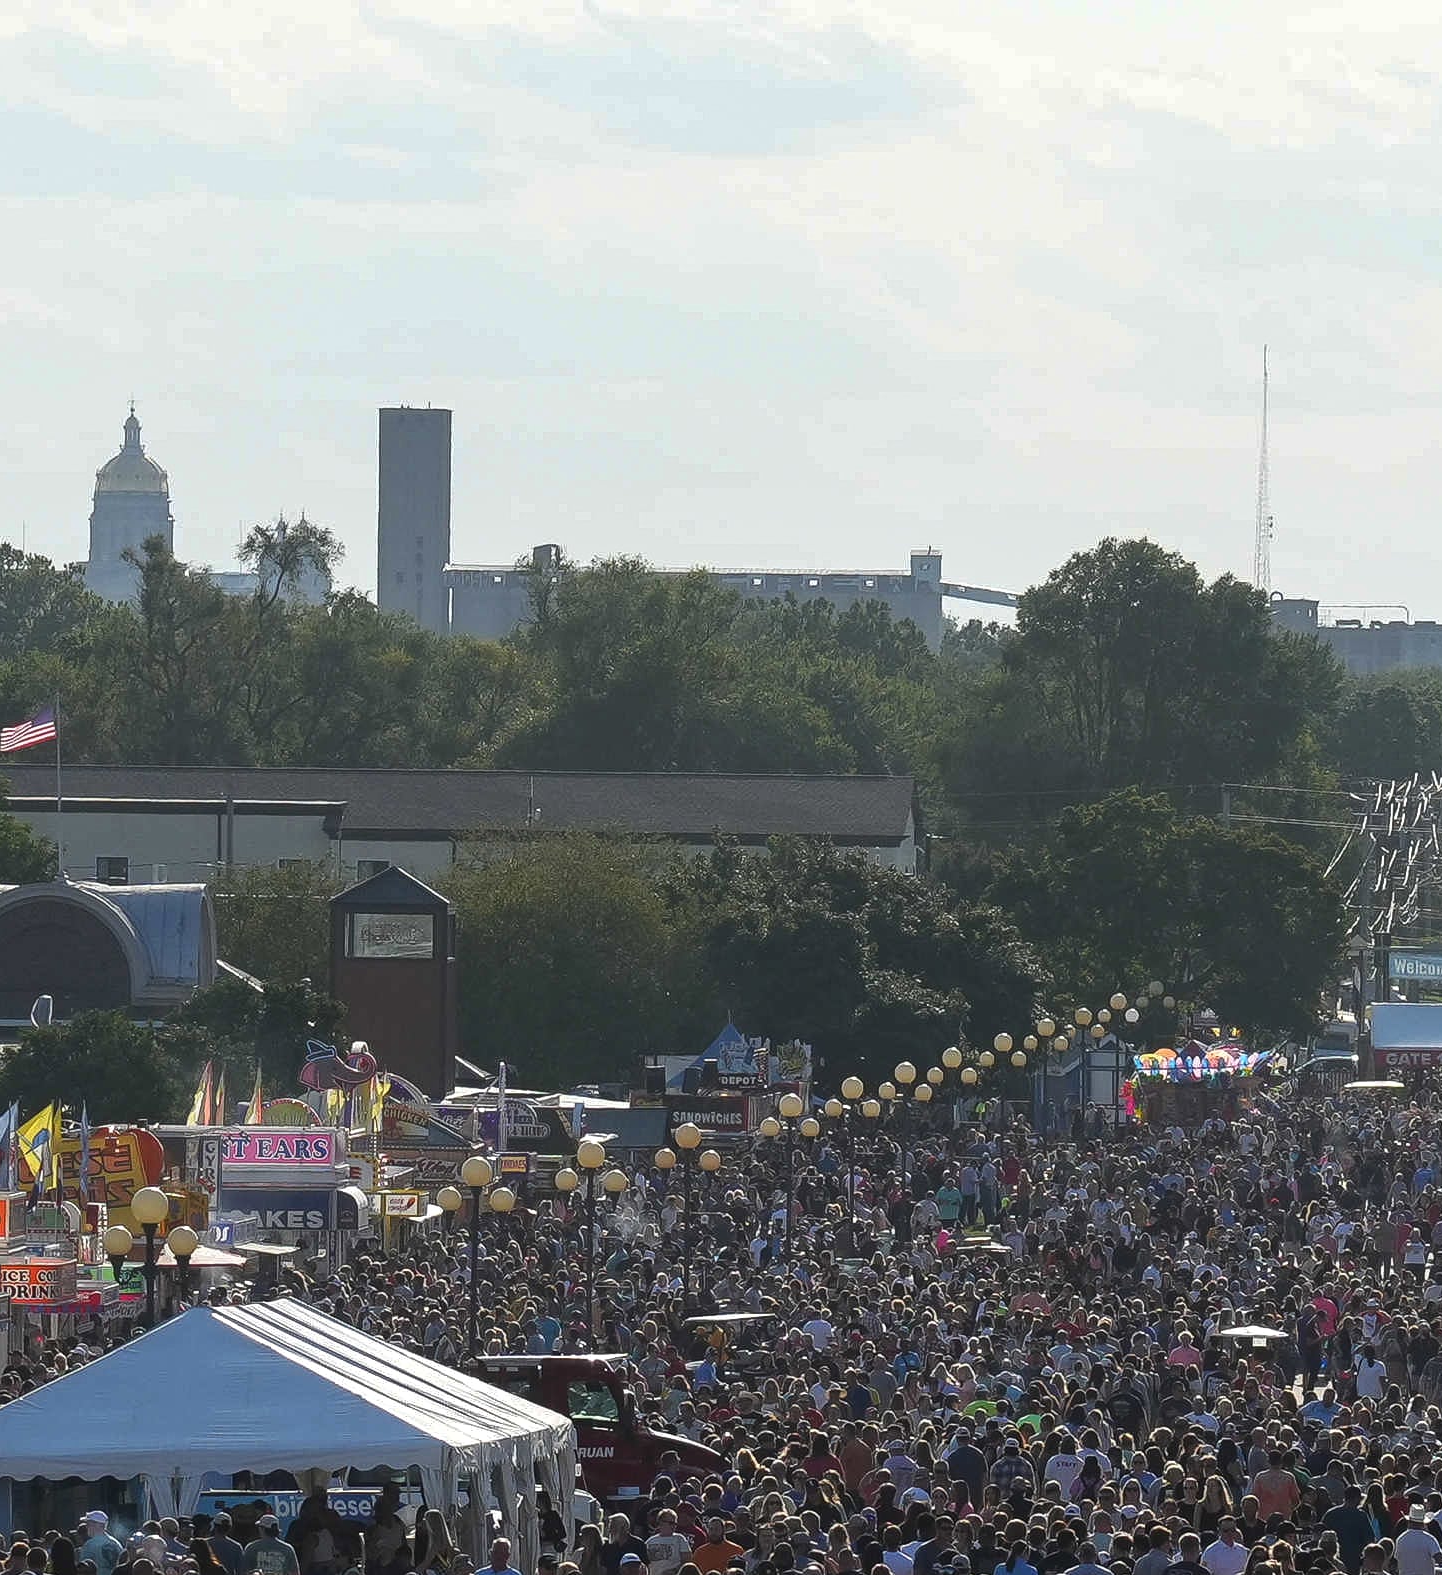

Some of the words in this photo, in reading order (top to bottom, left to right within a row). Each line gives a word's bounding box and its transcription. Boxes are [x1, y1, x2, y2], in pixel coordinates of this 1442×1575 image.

[1386, 1053, 1431, 1066] GATE
[721, 1076, 756, 1085] DEPOT
[672, 1111, 742, 1125] SANDWICHES
[257, 1138, 328, 1160] EARS
[235, 1209, 324, 1228] AKES
[2, 1271, 30, 1282] ICE
[578, 1446, 615, 1459] RUAN
